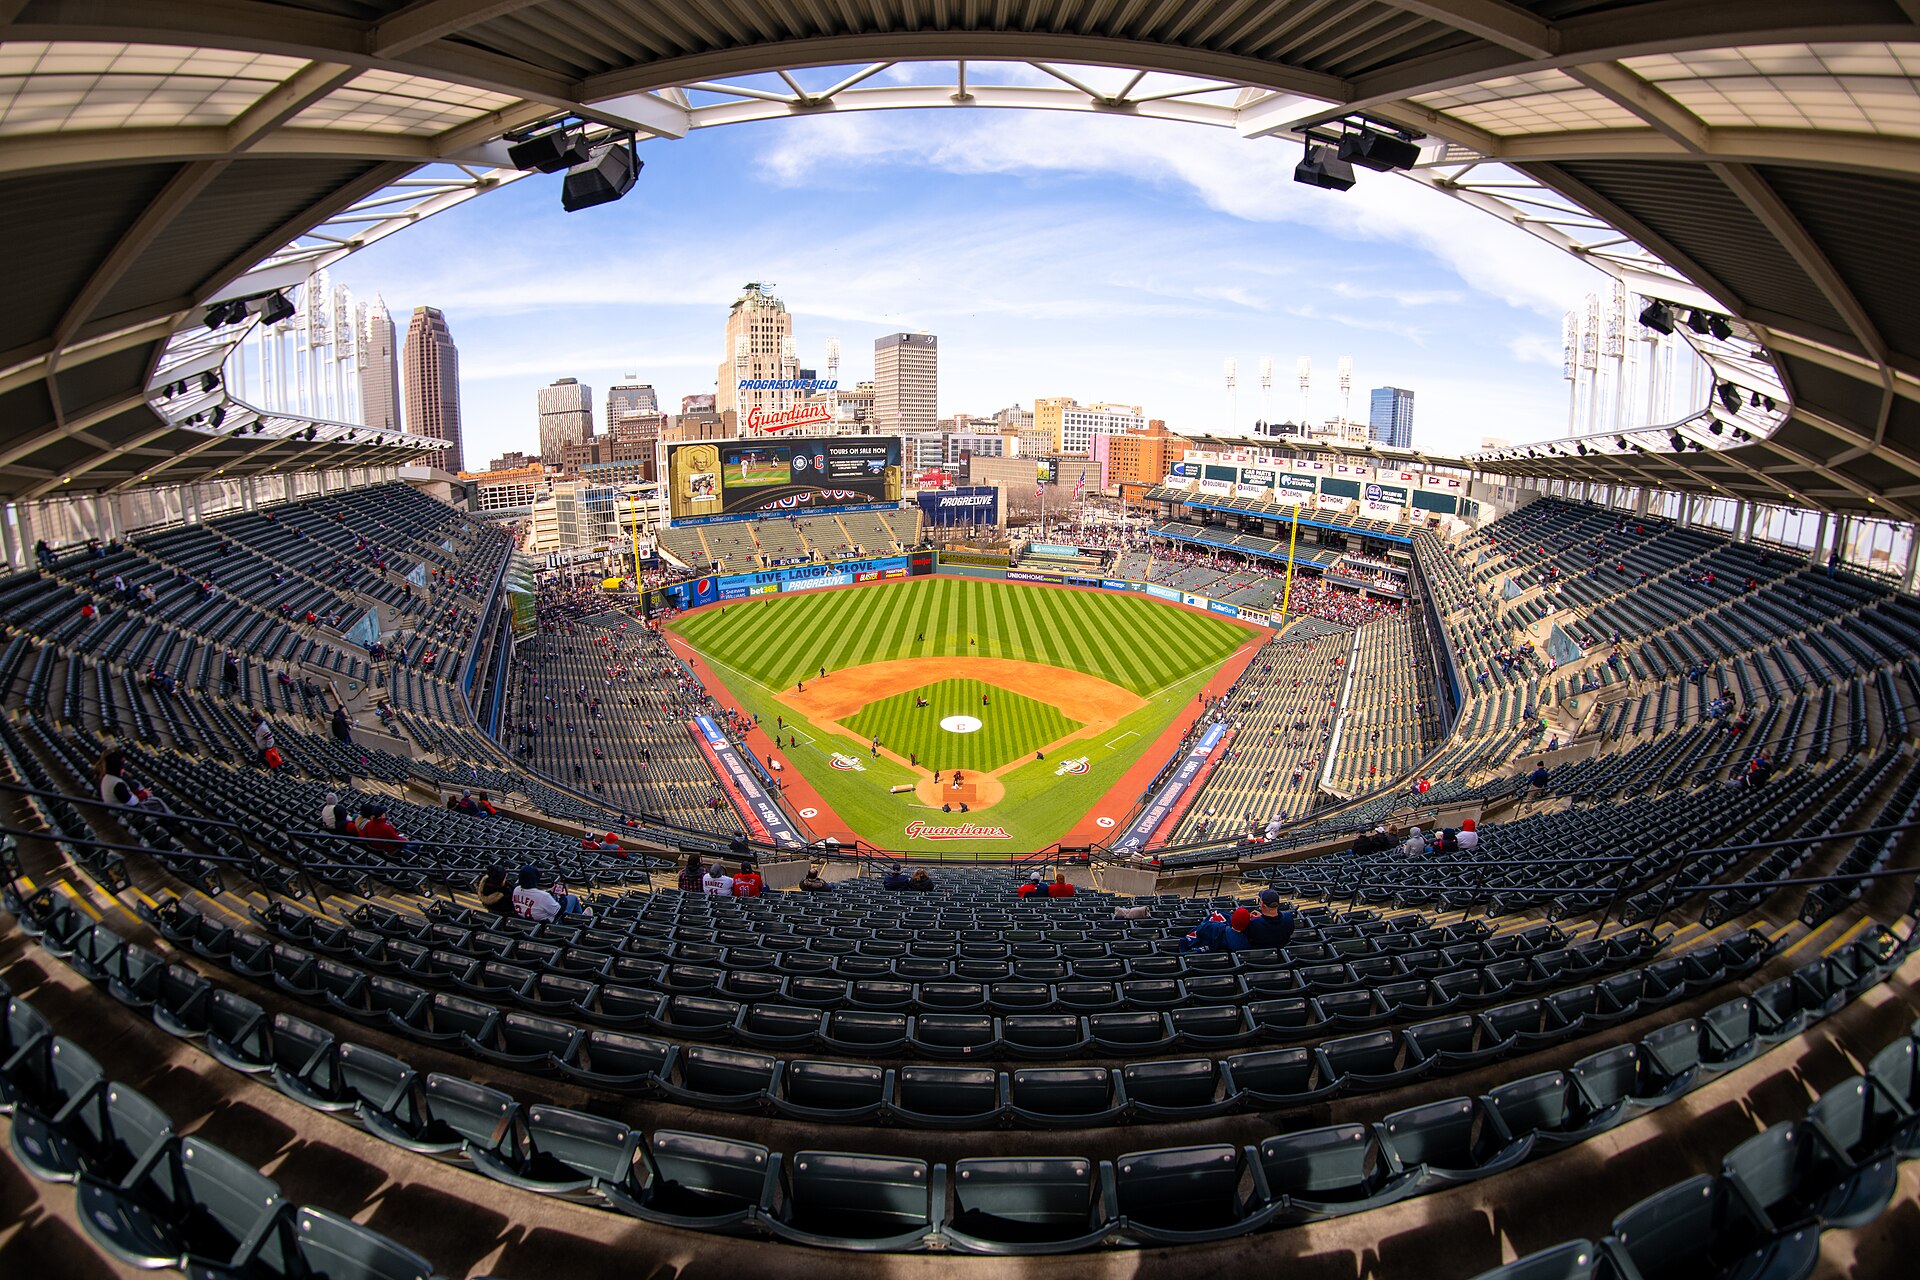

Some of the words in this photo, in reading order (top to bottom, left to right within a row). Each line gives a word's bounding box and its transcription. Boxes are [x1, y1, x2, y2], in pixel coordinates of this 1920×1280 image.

[738, 380, 806, 390] PROGRESSIVE
[810, 380, 838, 390] FIELD
[748, 404, 831, 433] Guardians
[814, 454, 824, 470] C
[940, 496, 993, 507] PROGRESSIVE
[578, 551, 603, 562] BREWED
[755, 572, 786, 584] LIVE.
[839, 562, 876, 574] GLOVE.
[750, 585, 777, 595] bet365
[788, 575, 846, 592] PROGRESSIVE
[1212, 602, 1236, 615] DollarBank
[904, 820, 1014, 841] Guardians
[739, 885, 749, 897] 11
